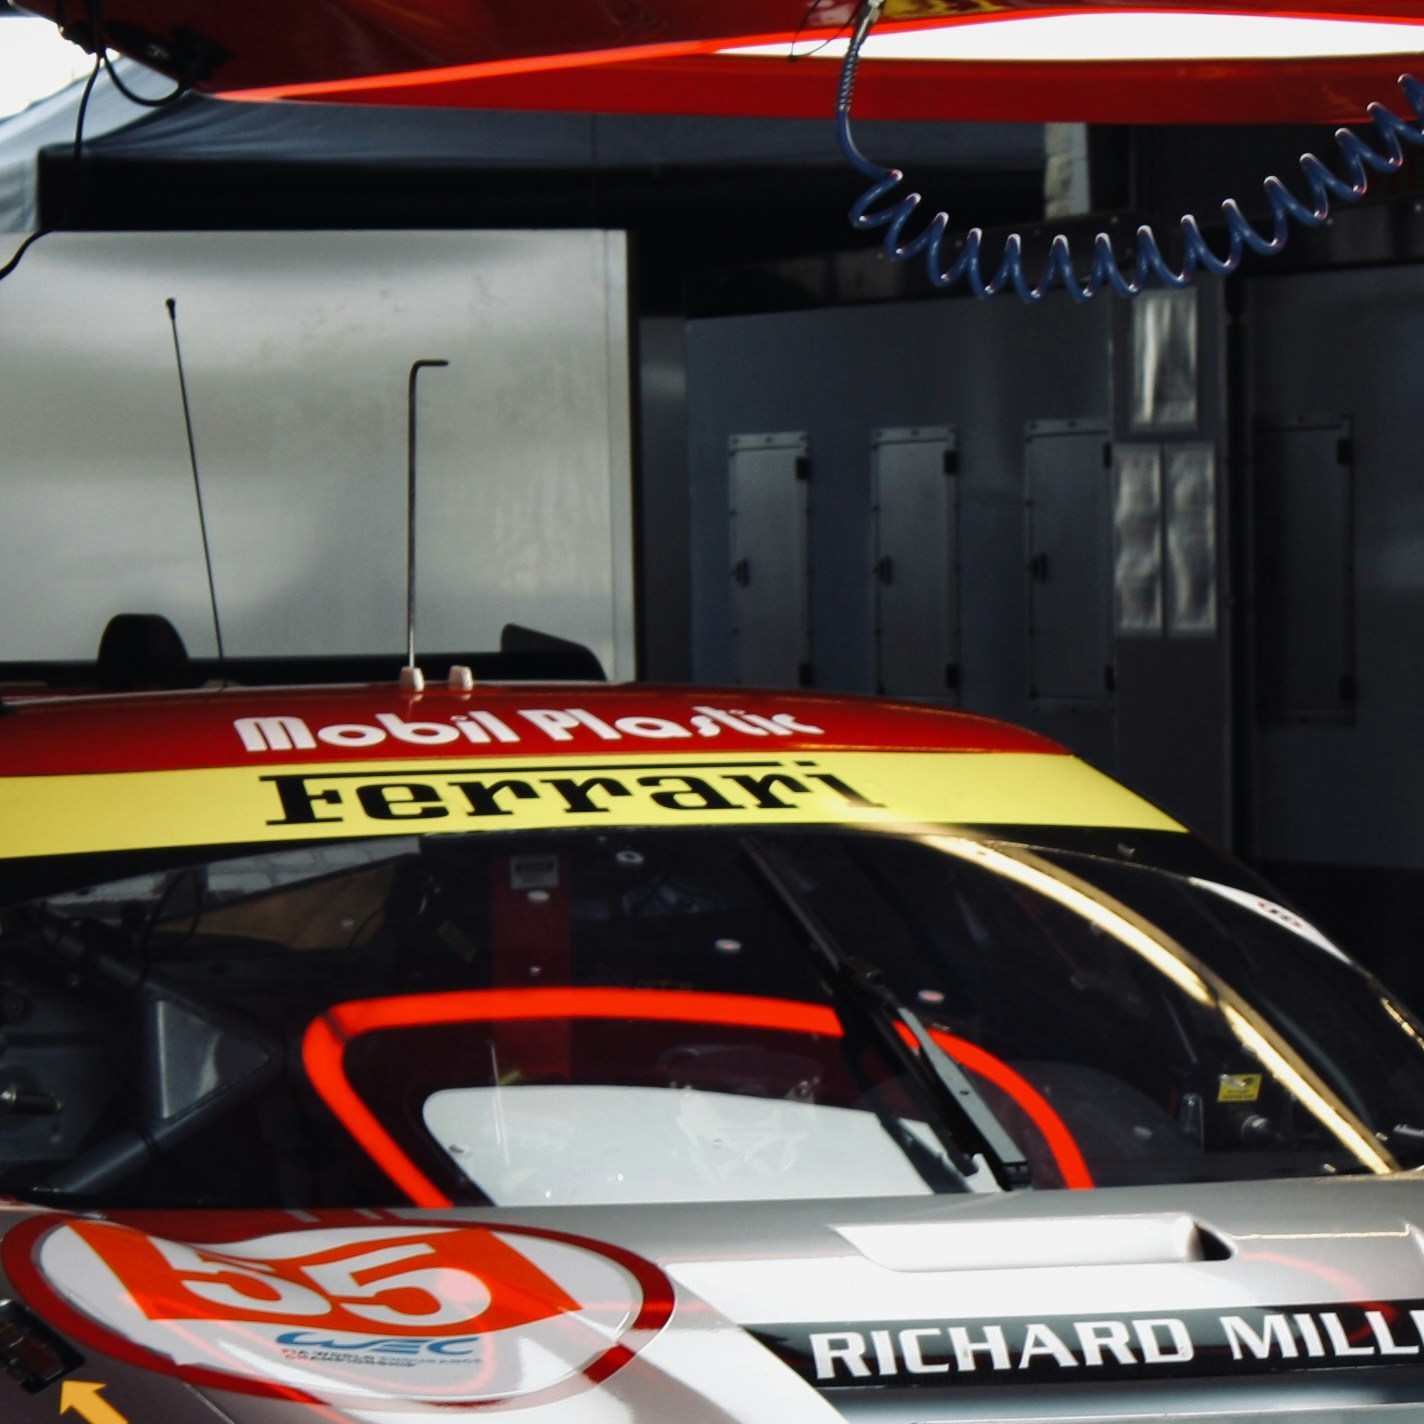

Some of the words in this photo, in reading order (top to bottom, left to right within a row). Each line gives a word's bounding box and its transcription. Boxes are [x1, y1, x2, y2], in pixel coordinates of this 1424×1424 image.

[233, 709, 521, 753] Mobil
[517, 705, 825, 743] Plastic
[259, 761, 887, 826] Ferrari
[147, 1234, 492, 1328] 55
[276, 1331, 480, 1355] WEC
[809, 1318, 1195, 1380] RICHARD
